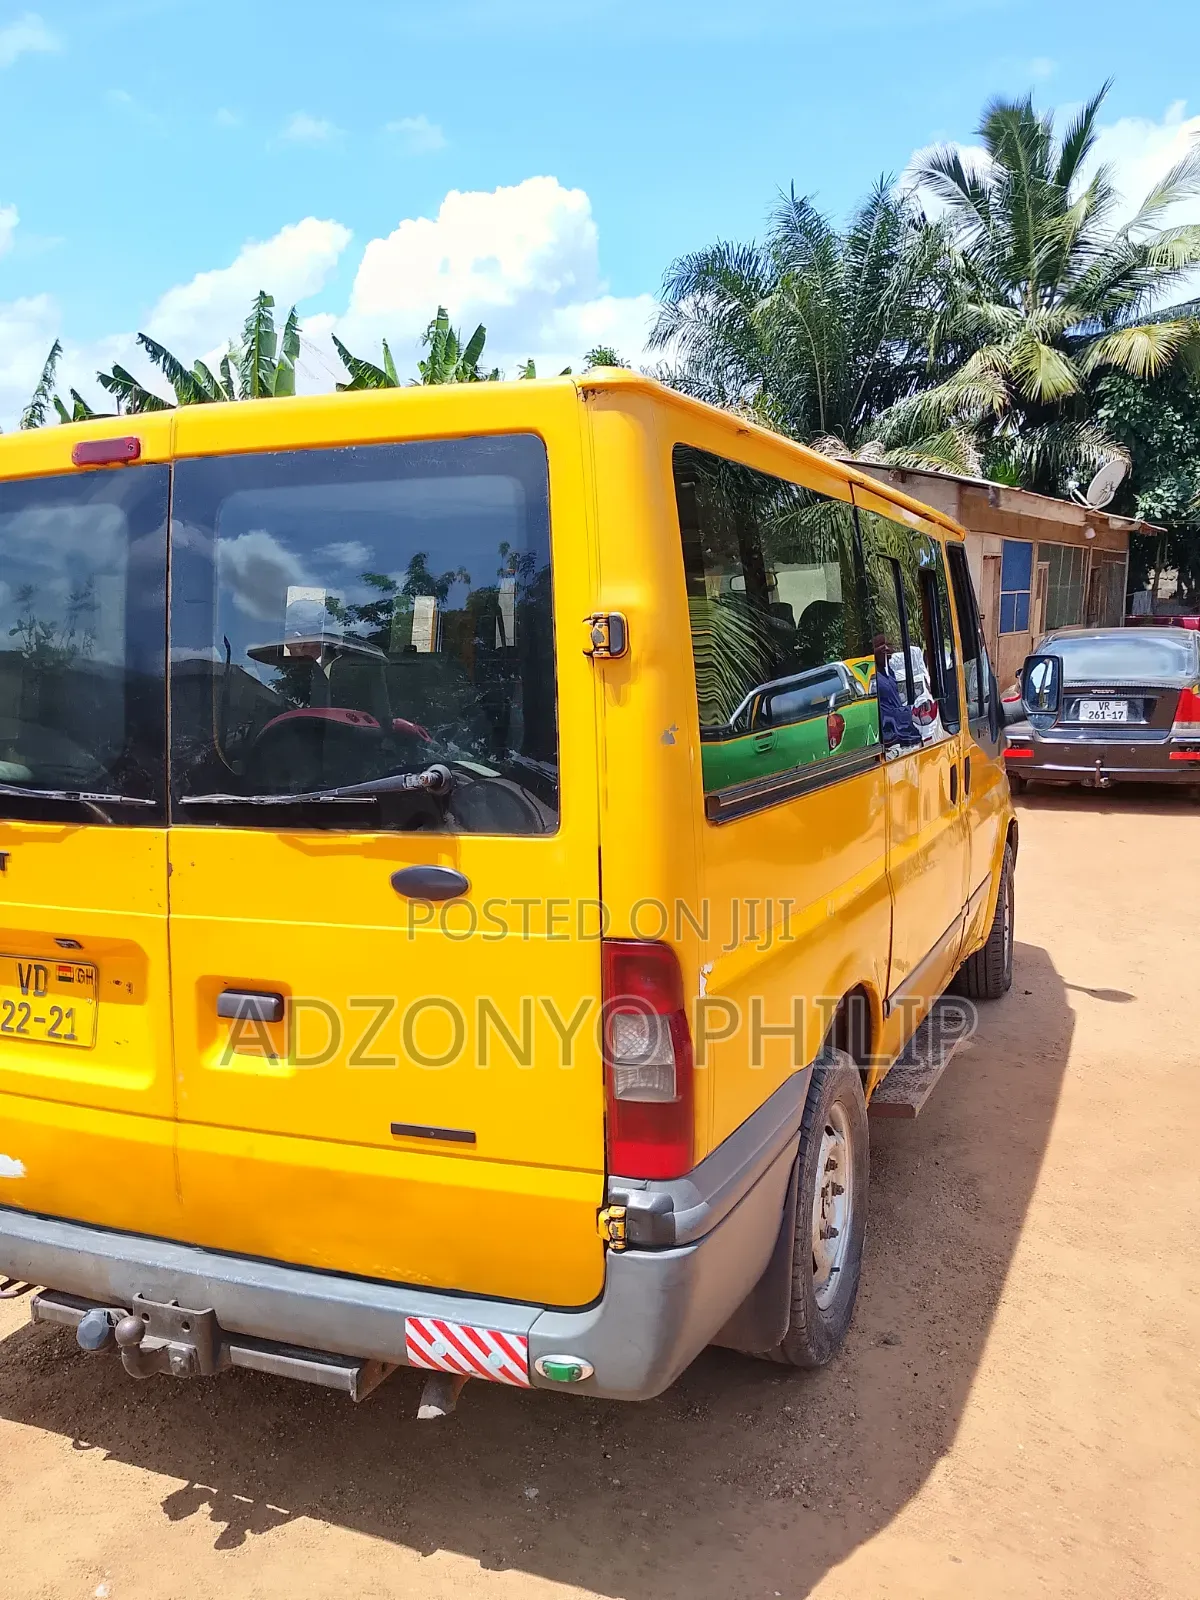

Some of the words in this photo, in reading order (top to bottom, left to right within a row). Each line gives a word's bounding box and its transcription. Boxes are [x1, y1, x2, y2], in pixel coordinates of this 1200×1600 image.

[1098, 701, 1110, 711] VR
[1088, 711, 1124, 720] 261-17
[17, 961, 50, 997] VD
[75, 966, 95, 985] GH
